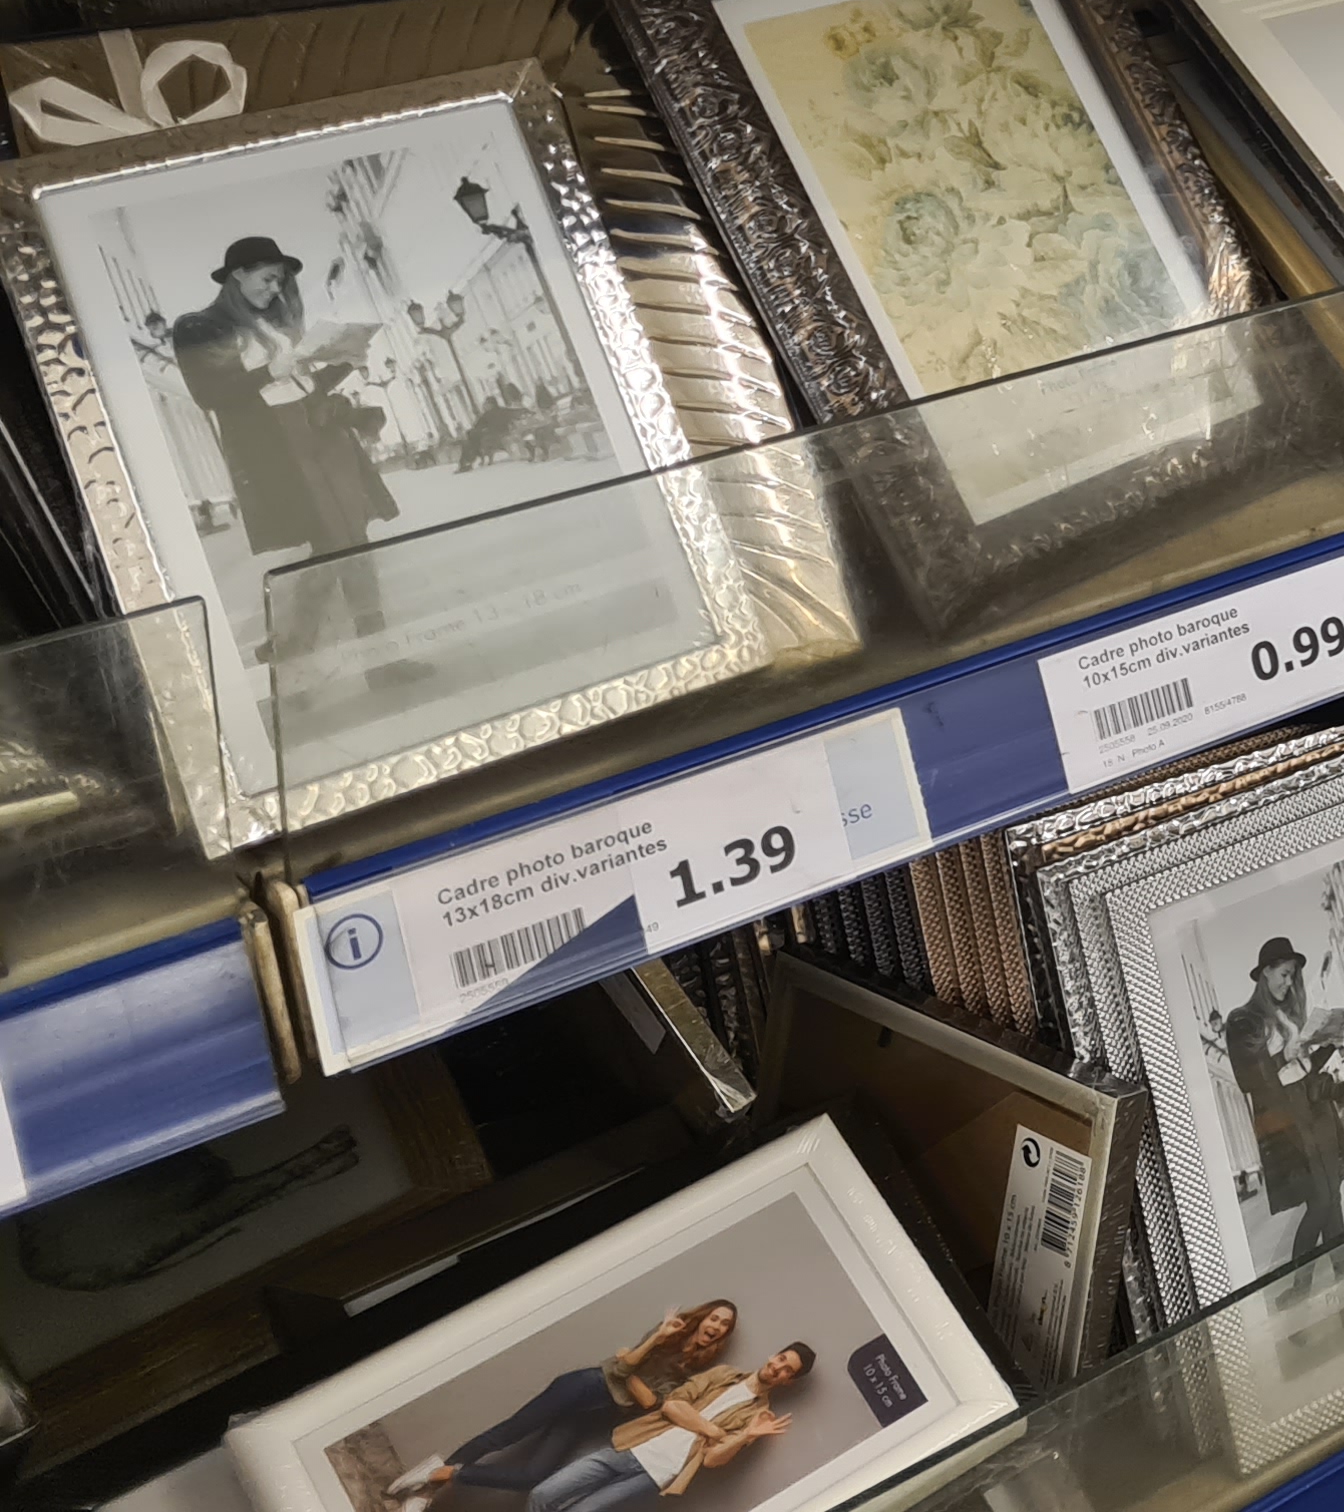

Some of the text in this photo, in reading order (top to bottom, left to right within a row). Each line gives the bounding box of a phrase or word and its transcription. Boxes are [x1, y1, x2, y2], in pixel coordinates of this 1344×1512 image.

[1077, 606, 1239, 671] Cadre photo baroque
[1083, 621, 1251, 689] 10x15cm div.variantes
[1131, 743, 1157, 758] Photo
[436, 820, 654, 908] Cadre photo baroque
[442, 835, 669, 928] 13x18cm div.variantes
[668, 824, 798, 909] 1.39
[863, 1364, 875, 1376] 10
[875, 1382, 888, 1395] 15
[882, 1395, 893, 1408] cm
[875, 1353, 907, 1401] Photo Frame
